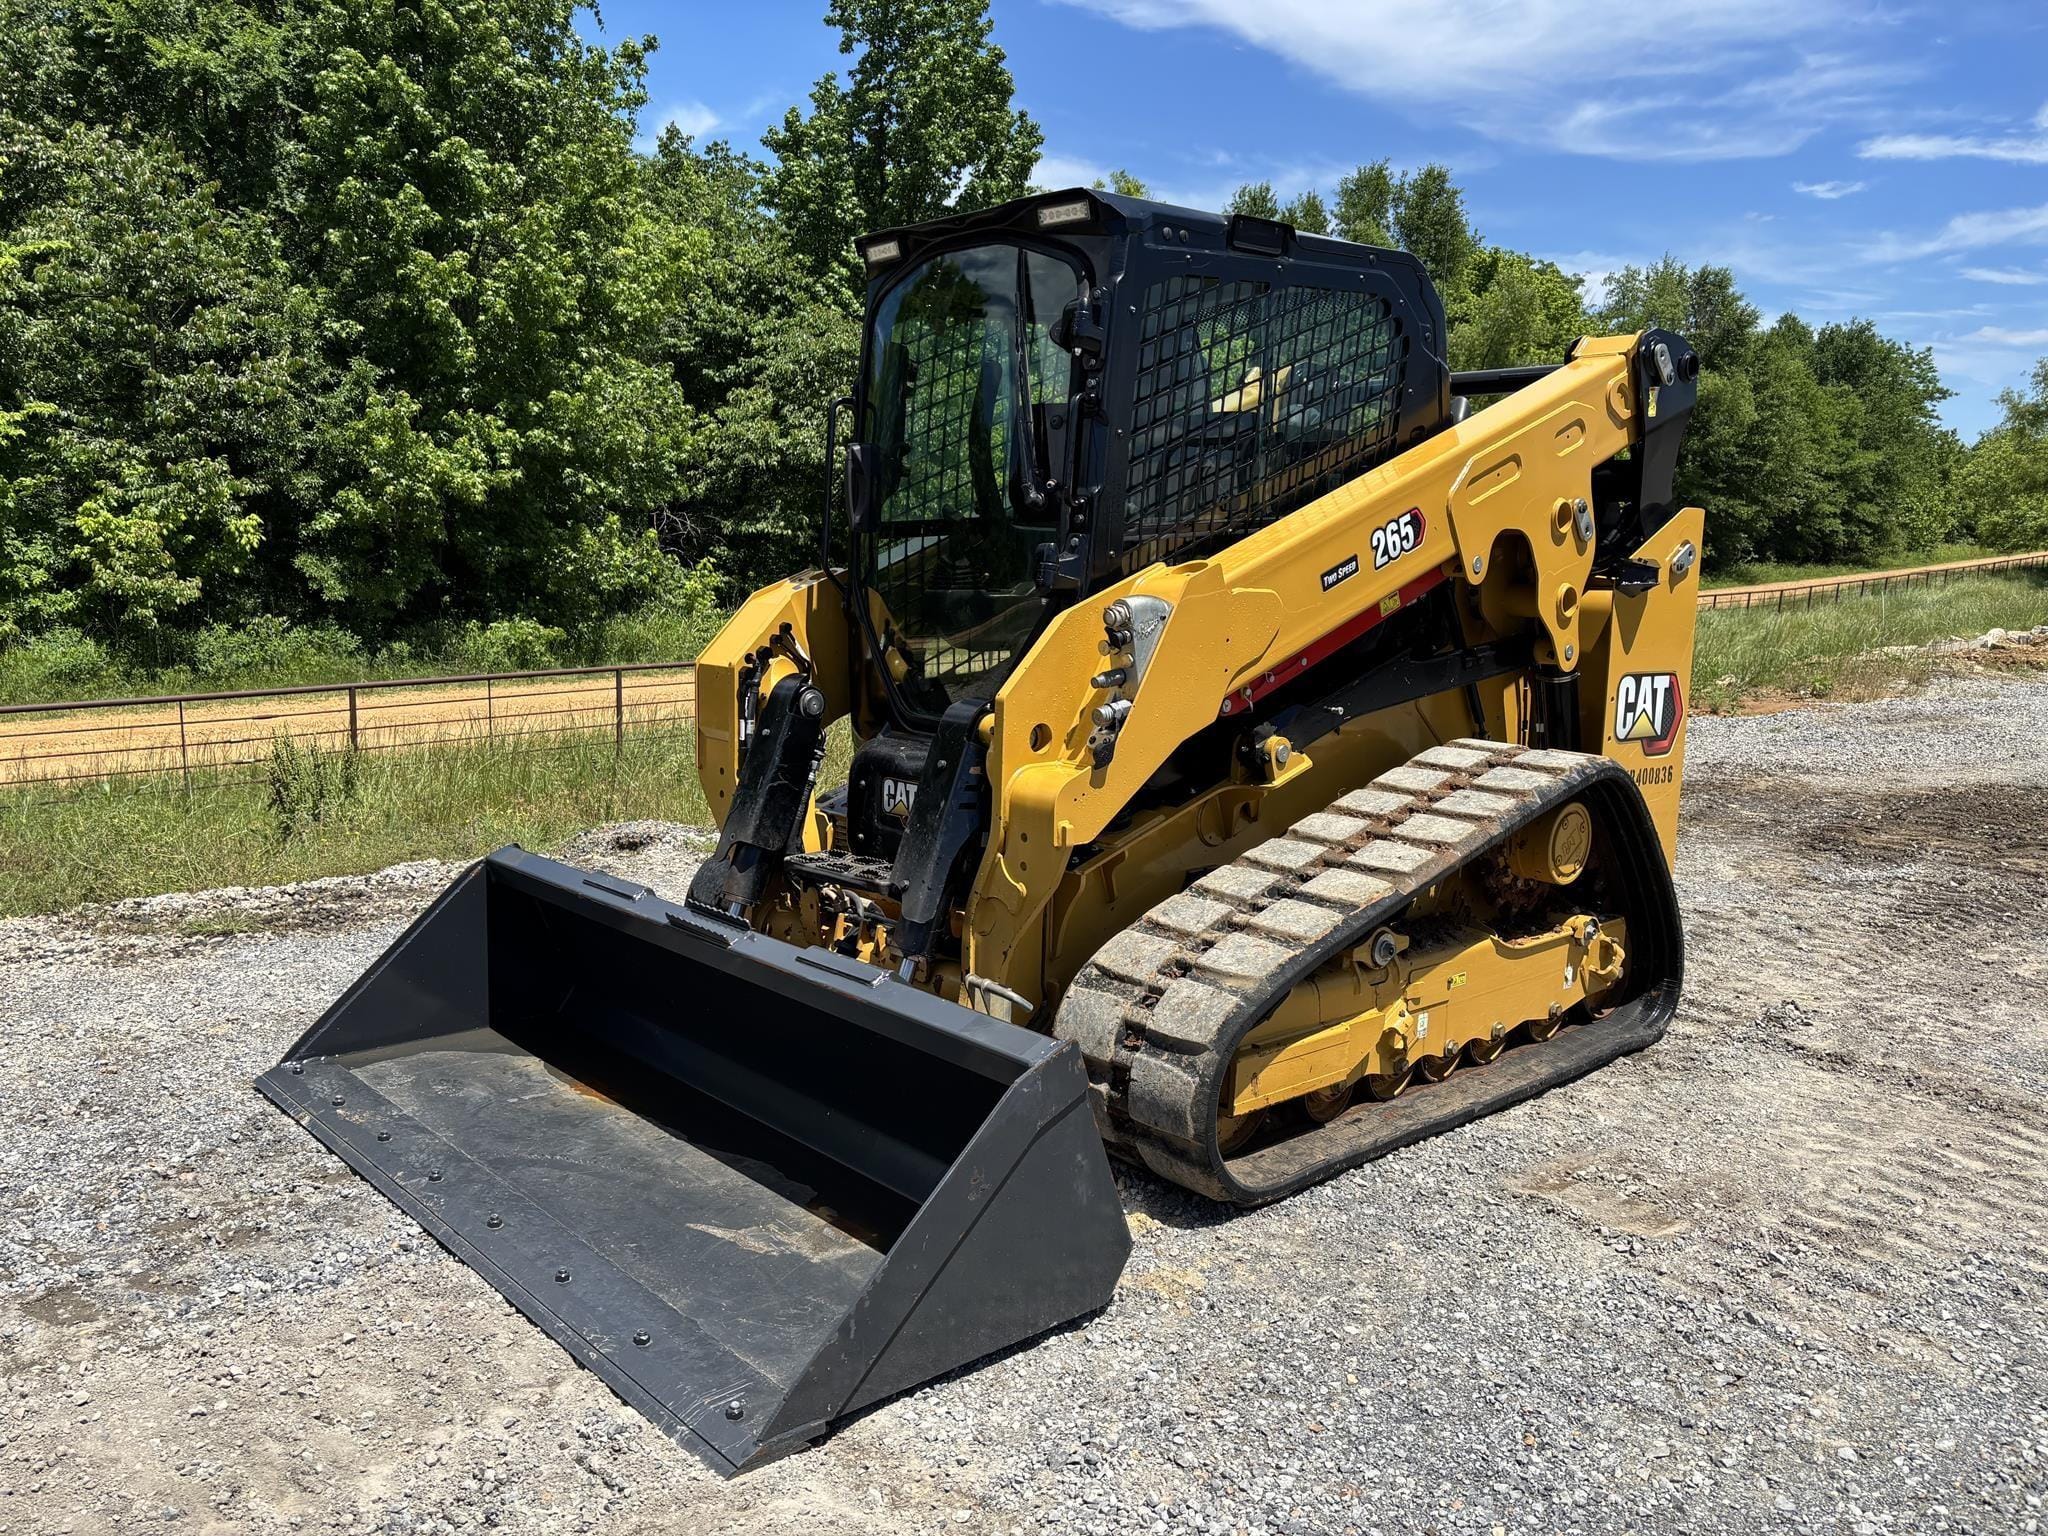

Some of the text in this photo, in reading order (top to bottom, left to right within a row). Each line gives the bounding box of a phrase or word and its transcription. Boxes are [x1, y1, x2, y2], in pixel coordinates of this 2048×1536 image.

[1371, 512, 1415, 568] 265
[1616, 675, 1671, 740] CAT
[883, 779, 918, 812] CAT
